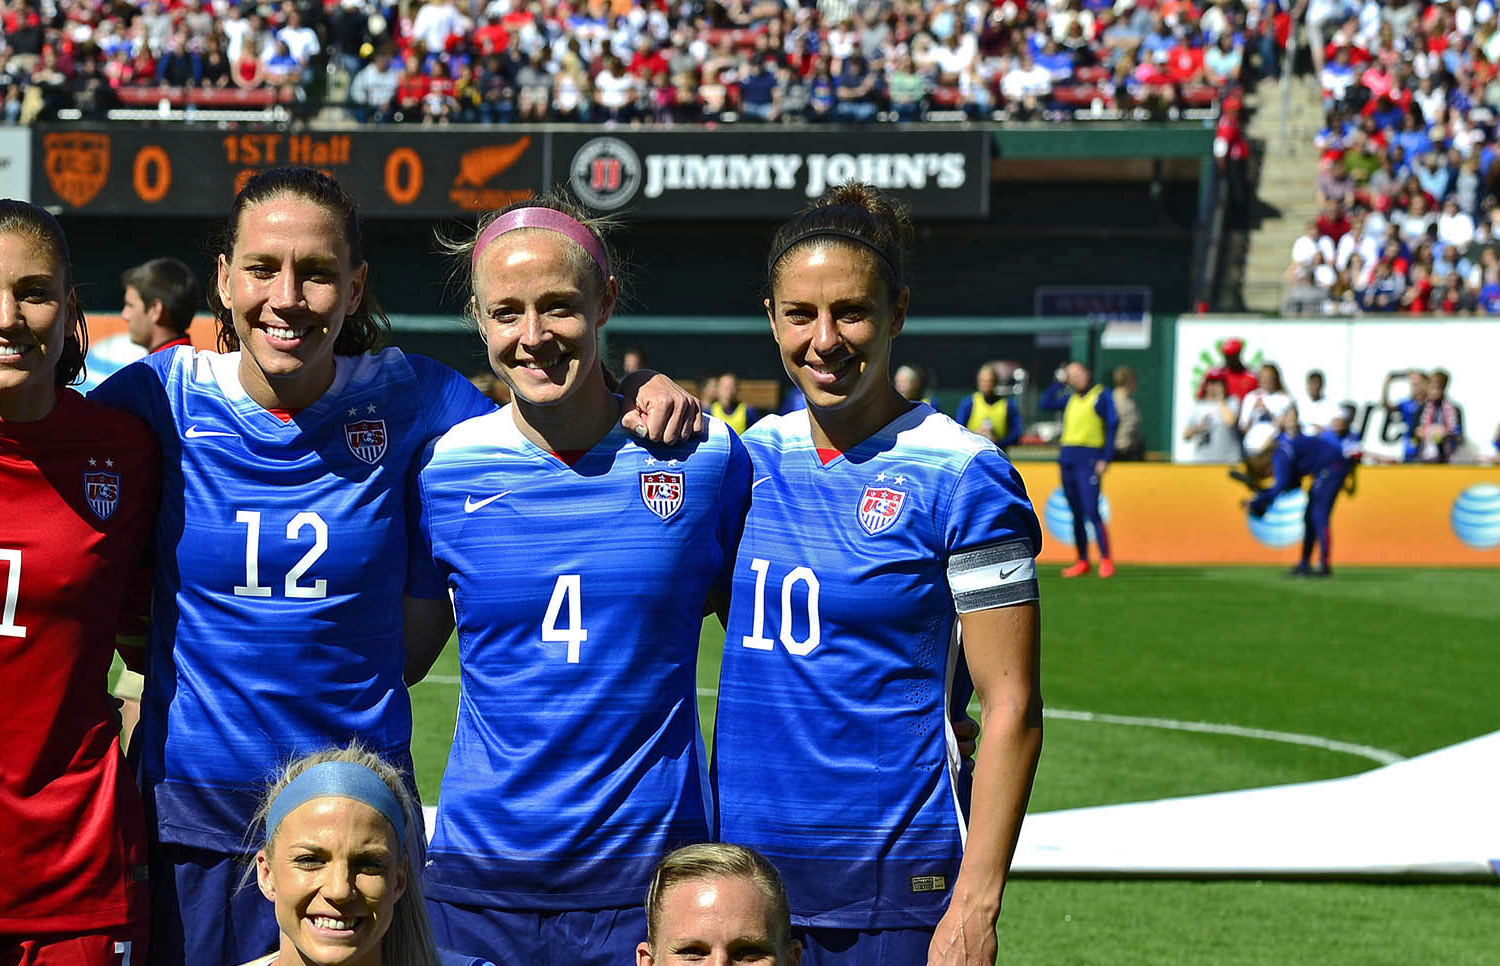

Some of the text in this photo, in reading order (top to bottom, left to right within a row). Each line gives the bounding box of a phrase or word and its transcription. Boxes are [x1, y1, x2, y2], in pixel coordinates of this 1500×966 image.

[133, 145, 172, 204] 0
[223, 134, 351, 165] 1ST Half
[384, 147, 424, 205] 0
[644, 152, 966, 198] JIMMY JOHN'S
[233, 510, 329, 599] 12
[541, 574, 588, 664] 4
[742, 558, 821, 656] 10
